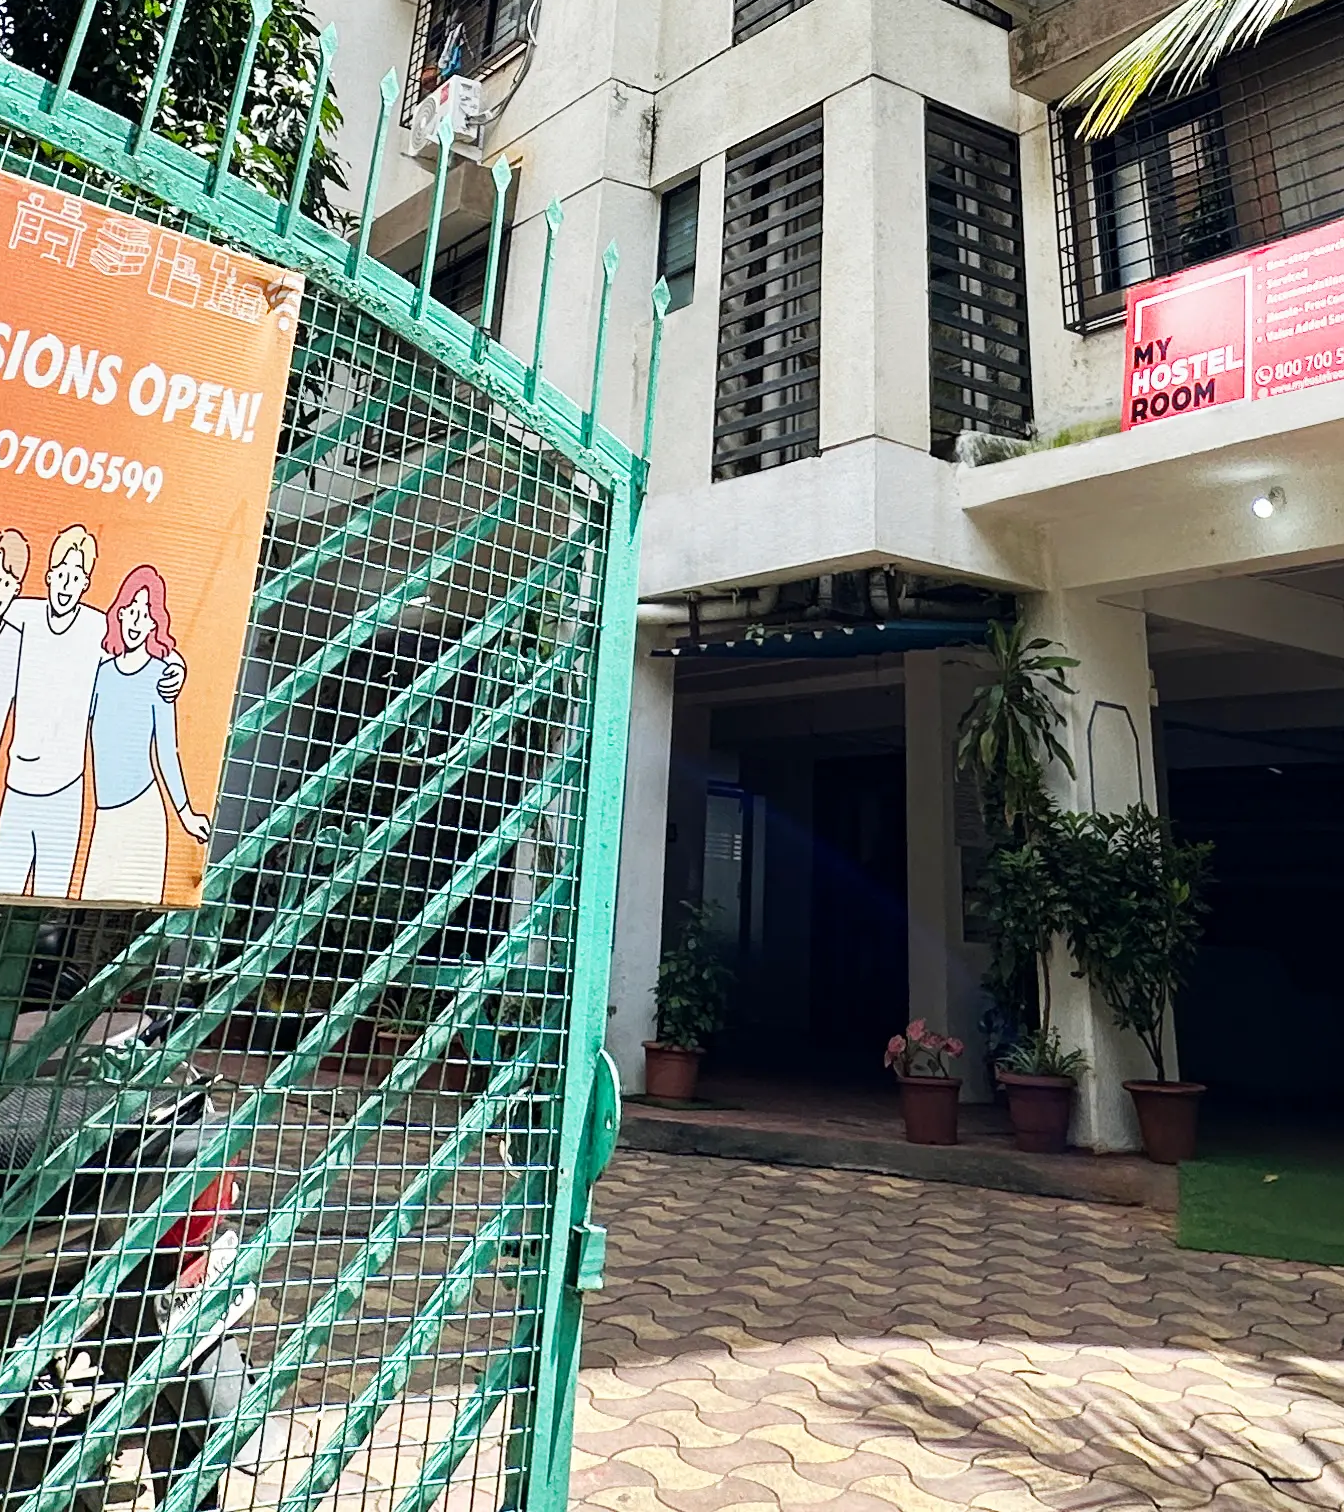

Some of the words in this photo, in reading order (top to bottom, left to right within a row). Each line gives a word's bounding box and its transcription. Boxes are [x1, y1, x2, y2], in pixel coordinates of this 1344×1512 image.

[1131, 345, 1244, 397] HOSTEL
[1133, 336, 1173, 369] MY
[1274, 358, 1302, 380] 800
[1305, 351, 1333, 372] 700
[129, 362, 263, 443] OPEN!
[1130, 378, 1215, 423] ROOM
